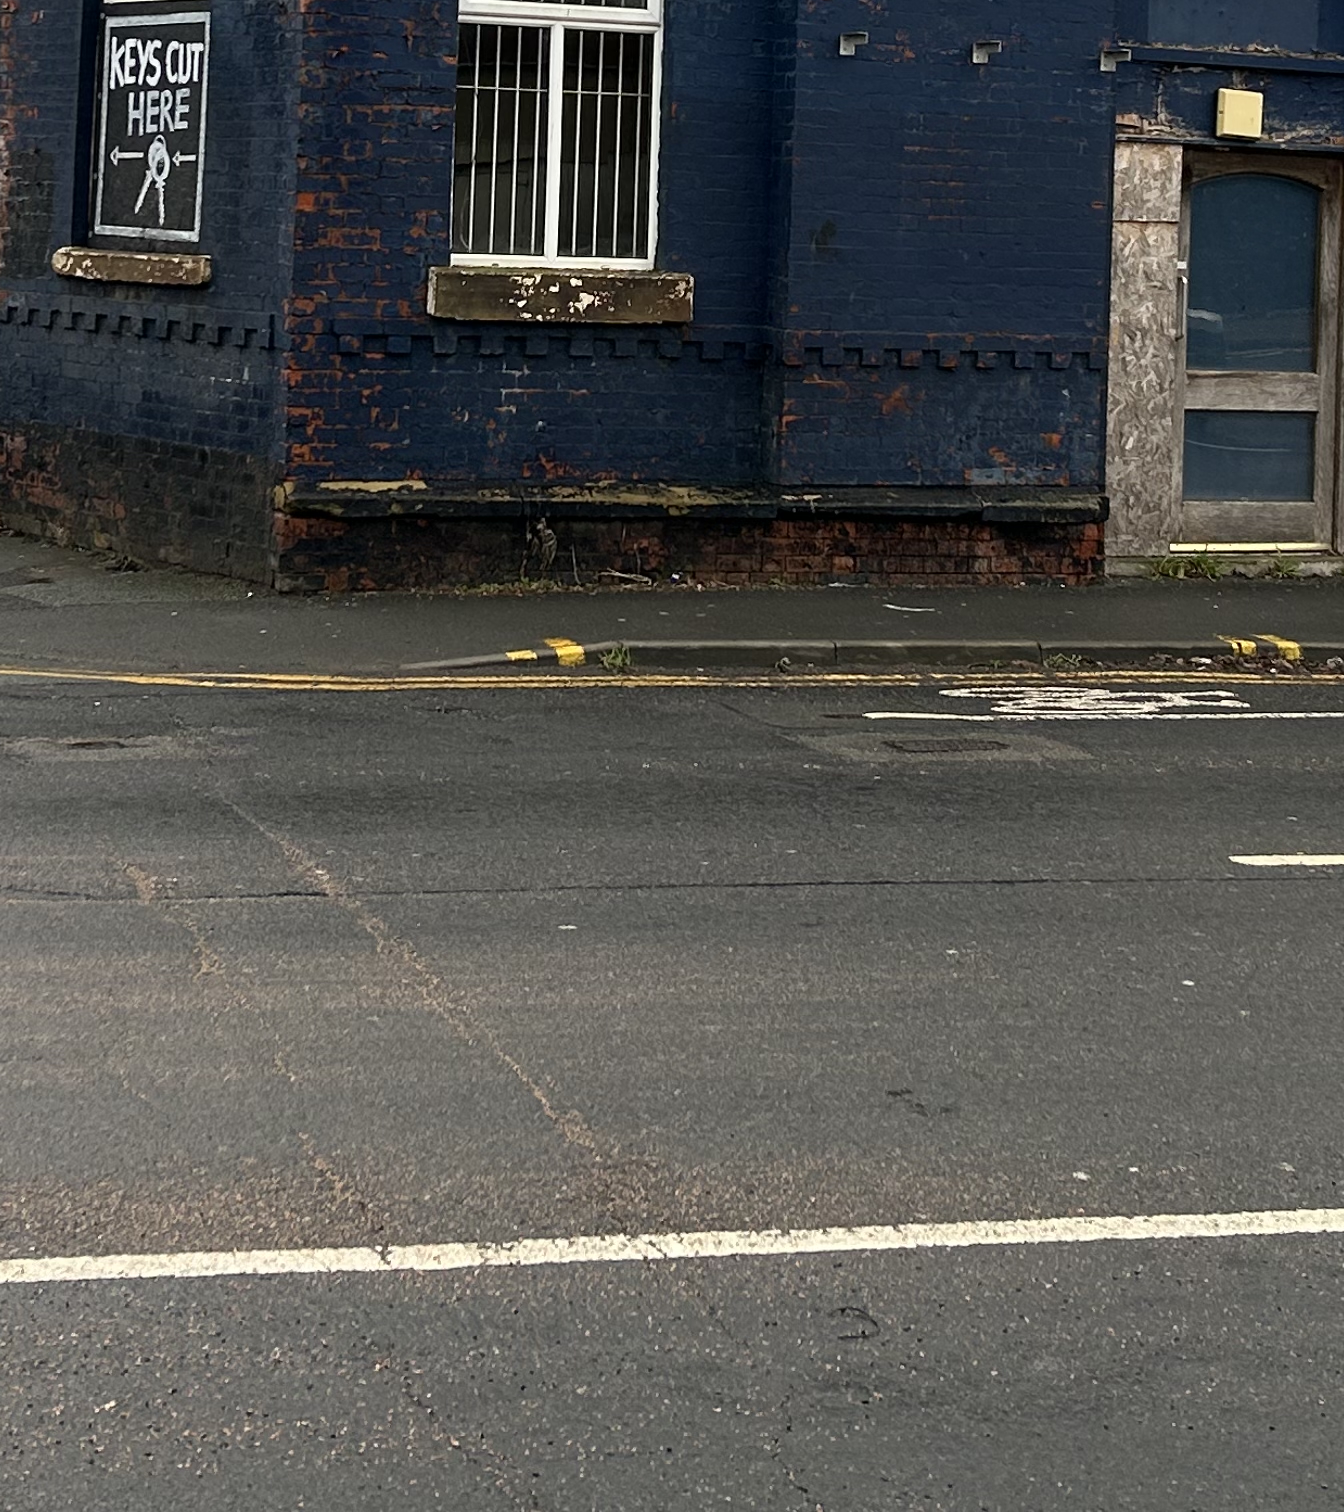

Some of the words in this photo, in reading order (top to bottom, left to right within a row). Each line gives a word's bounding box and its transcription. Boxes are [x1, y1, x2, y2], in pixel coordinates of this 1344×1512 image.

[110, 36, 162, 90] KEYS
[166, 40, 204, 84] CUT
[127, 88, 190, 136] HERE
